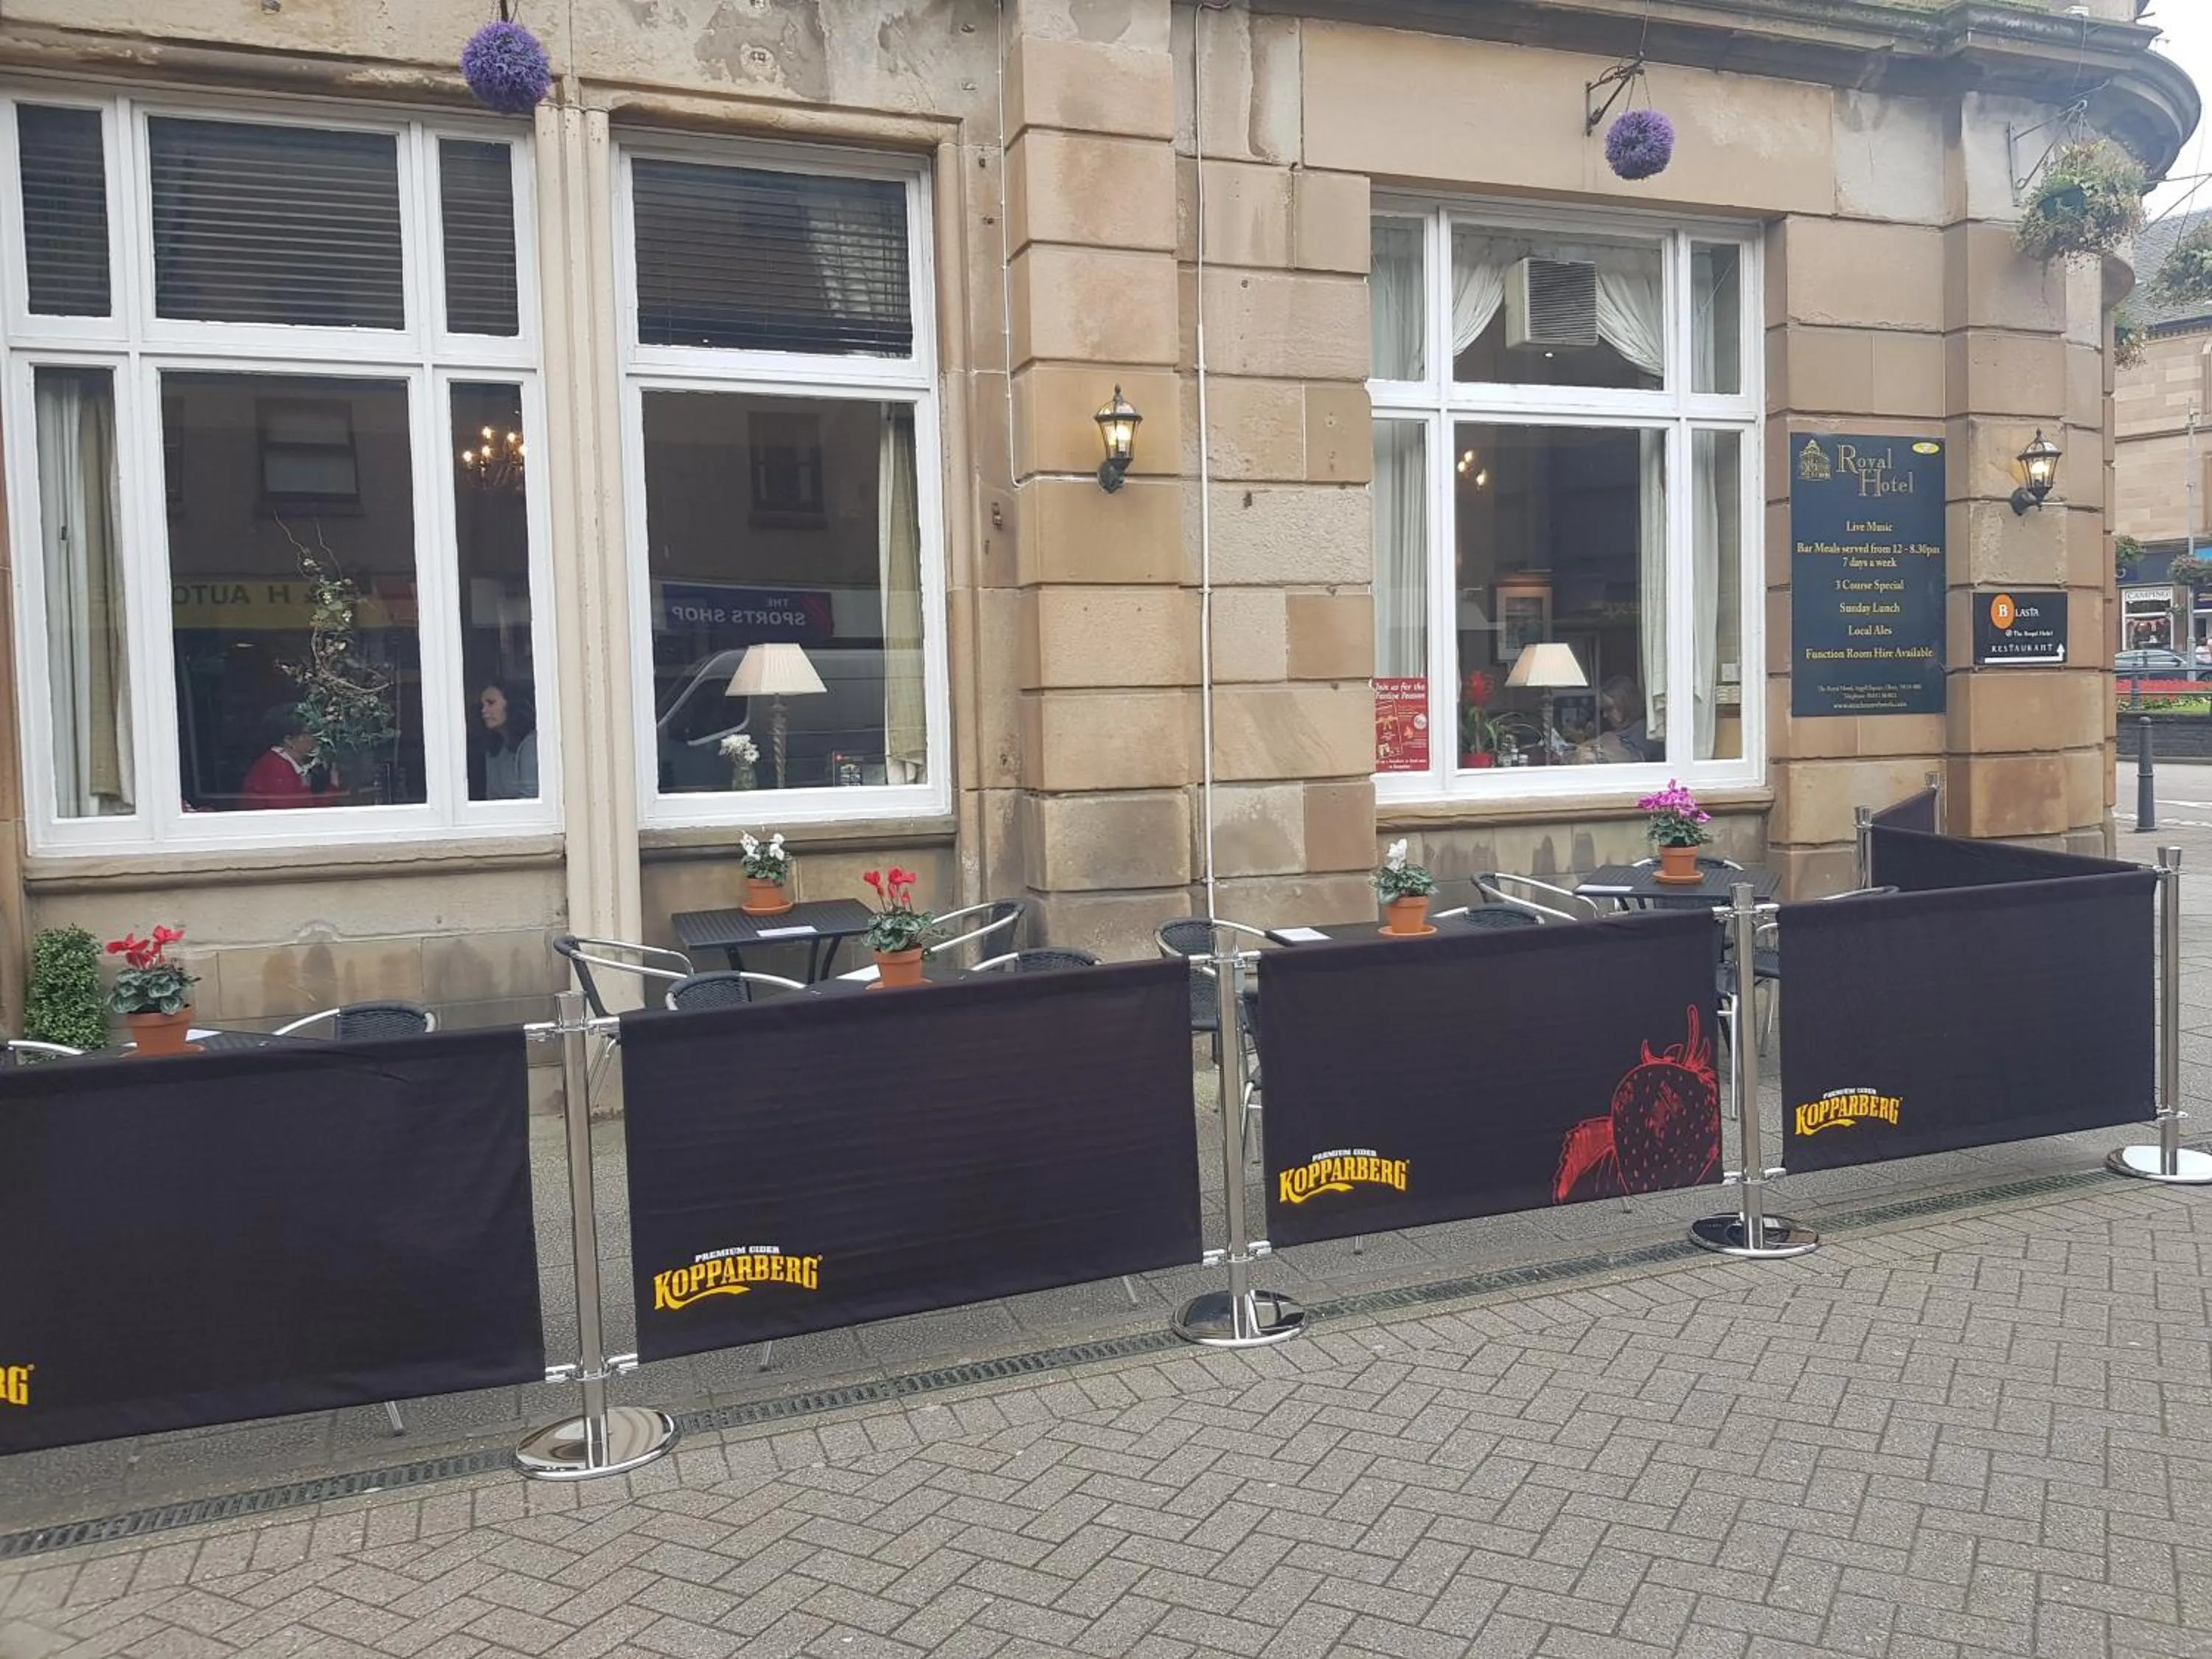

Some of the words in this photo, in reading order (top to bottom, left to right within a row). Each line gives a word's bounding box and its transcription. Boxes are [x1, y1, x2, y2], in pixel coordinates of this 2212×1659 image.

[1835, 444, 1893, 474] Royal
[1857, 468, 1913, 496] Hotel
[1846, 521, 1865, 532] Live
[1867, 521, 1893, 532] Music
[1797, 543, 1812, 553] Bar
[1815, 543, 1840, 553] Meals
[1842, 543, 1869, 554] served
[1871, 543, 1891, 554] from
[1893, 544, 1902, 553] 12
[1910, 544, 1940, 558] 8.30pm
[1843, 557, 1848, 567] 7
[1850, 557, 1868, 571] days
[1876, 557, 1897, 567] week
[1843, 580, 1873, 590] Course
[1874, 579, 1905, 593] Special
[1840, 602, 1871, 616] Sunday
[1872, 602, 1900, 613] Lunch
[1848, 625, 1872, 636] Local
[1874, 625, 1893, 636] Ales
[1806, 647, 1844, 659] Function
[1846, 647, 1873, 658] Room
[1874, 647, 1894, 658] Hire
[1895, 646, 1933, 658] Available
[1992, 644, 2053, 653] RESTAURANT
[1823, 1088, 1856, 1099] PREMIUM
[1795, 1094, 1899, 1135] KOPPARBERG
[1312, 1148, 1352, 1162] PREMIUM
[1353, 1148, 1377, 1156] CIDER
[1279, 1156, 1406, 1203] KOPPARBERG
[695, 1246, 746, 1262] PREMIUM
[748, 1245, 780, 1253] CIDER
[653, 1254, 818, 1310] KOPPARBERG
